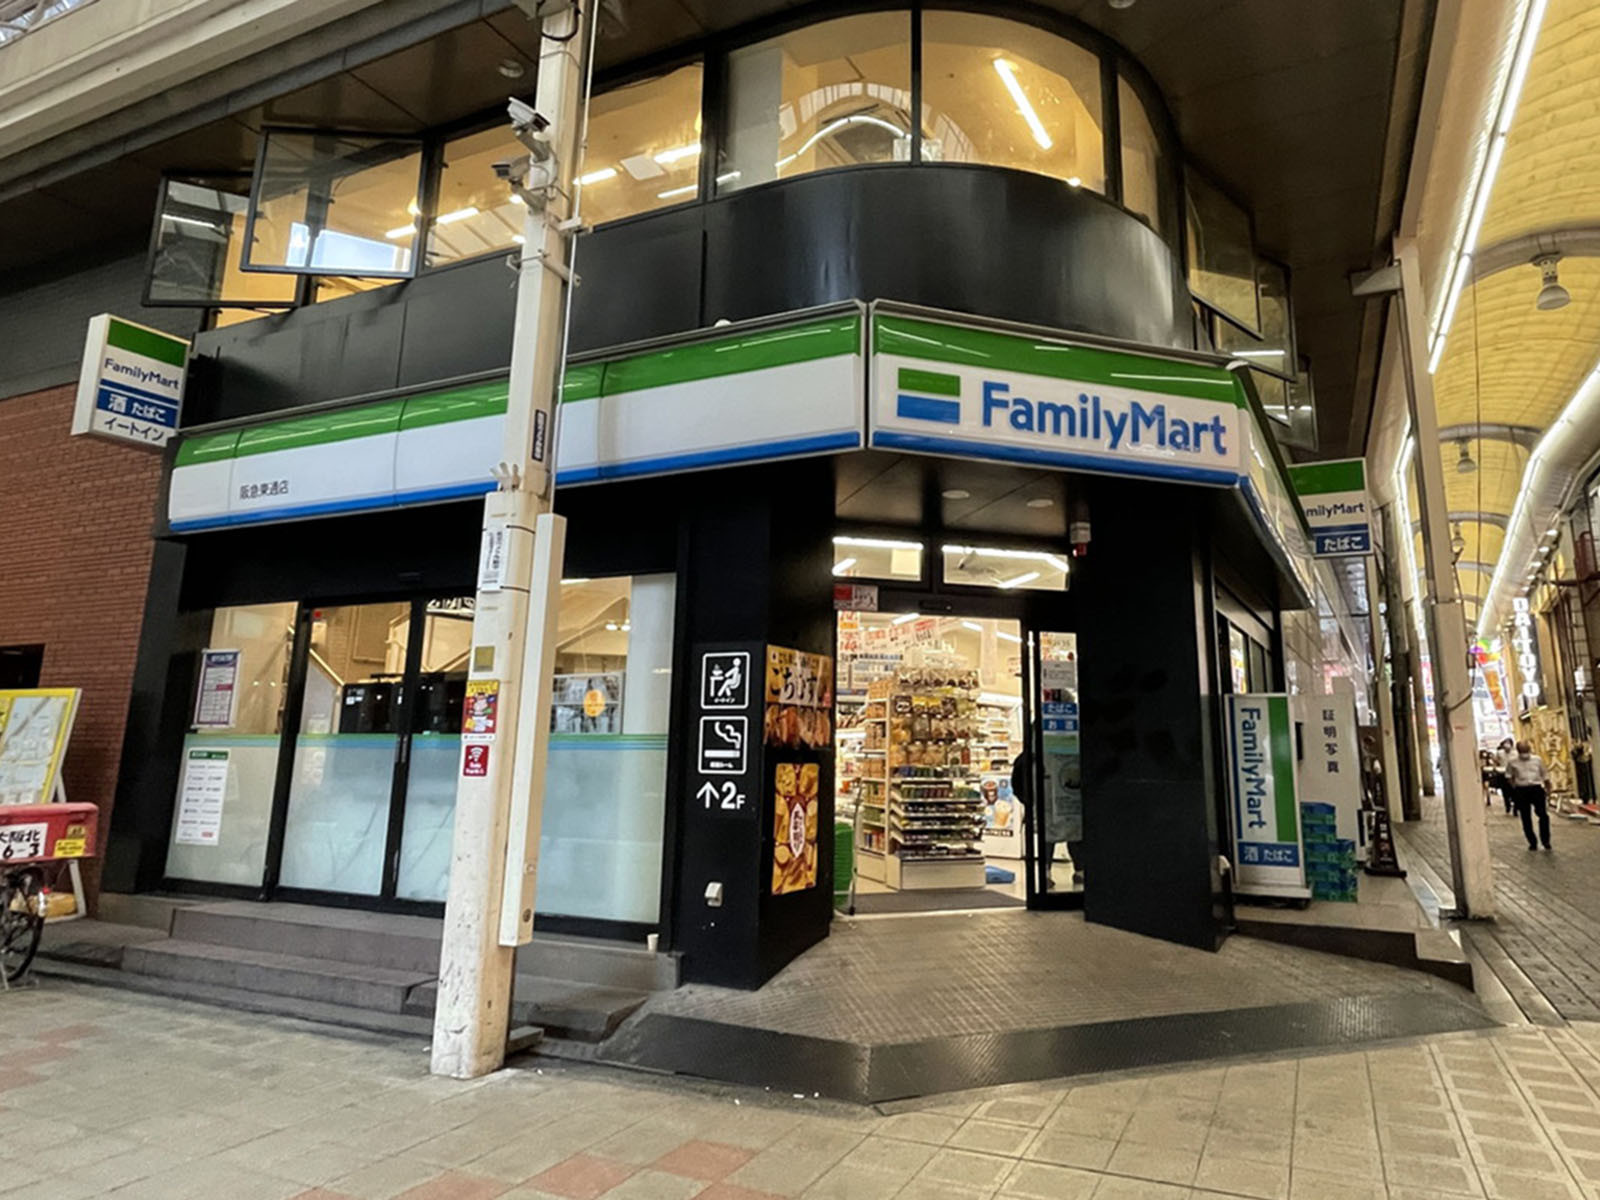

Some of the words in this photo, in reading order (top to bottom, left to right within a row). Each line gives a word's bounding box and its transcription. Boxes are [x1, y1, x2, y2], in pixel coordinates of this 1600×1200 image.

[104, 357, 179, 390] FamilyMart
[131, 401, 167, 422] たばこ
[982, 380, 1227, 455] FamilyMart
[104, 417, 164, 441] イートイン
[1304, 502, 1365, 518] milyMart
[1324, 536, 1364, 551] たばこ
[1322, 709, 1340, 773] 証明写真
[1241, 707, 1267, 829] FamilyMart
[721, 781, 746, 809] 2F
[1264, 849, 1294, 862] たばこ
